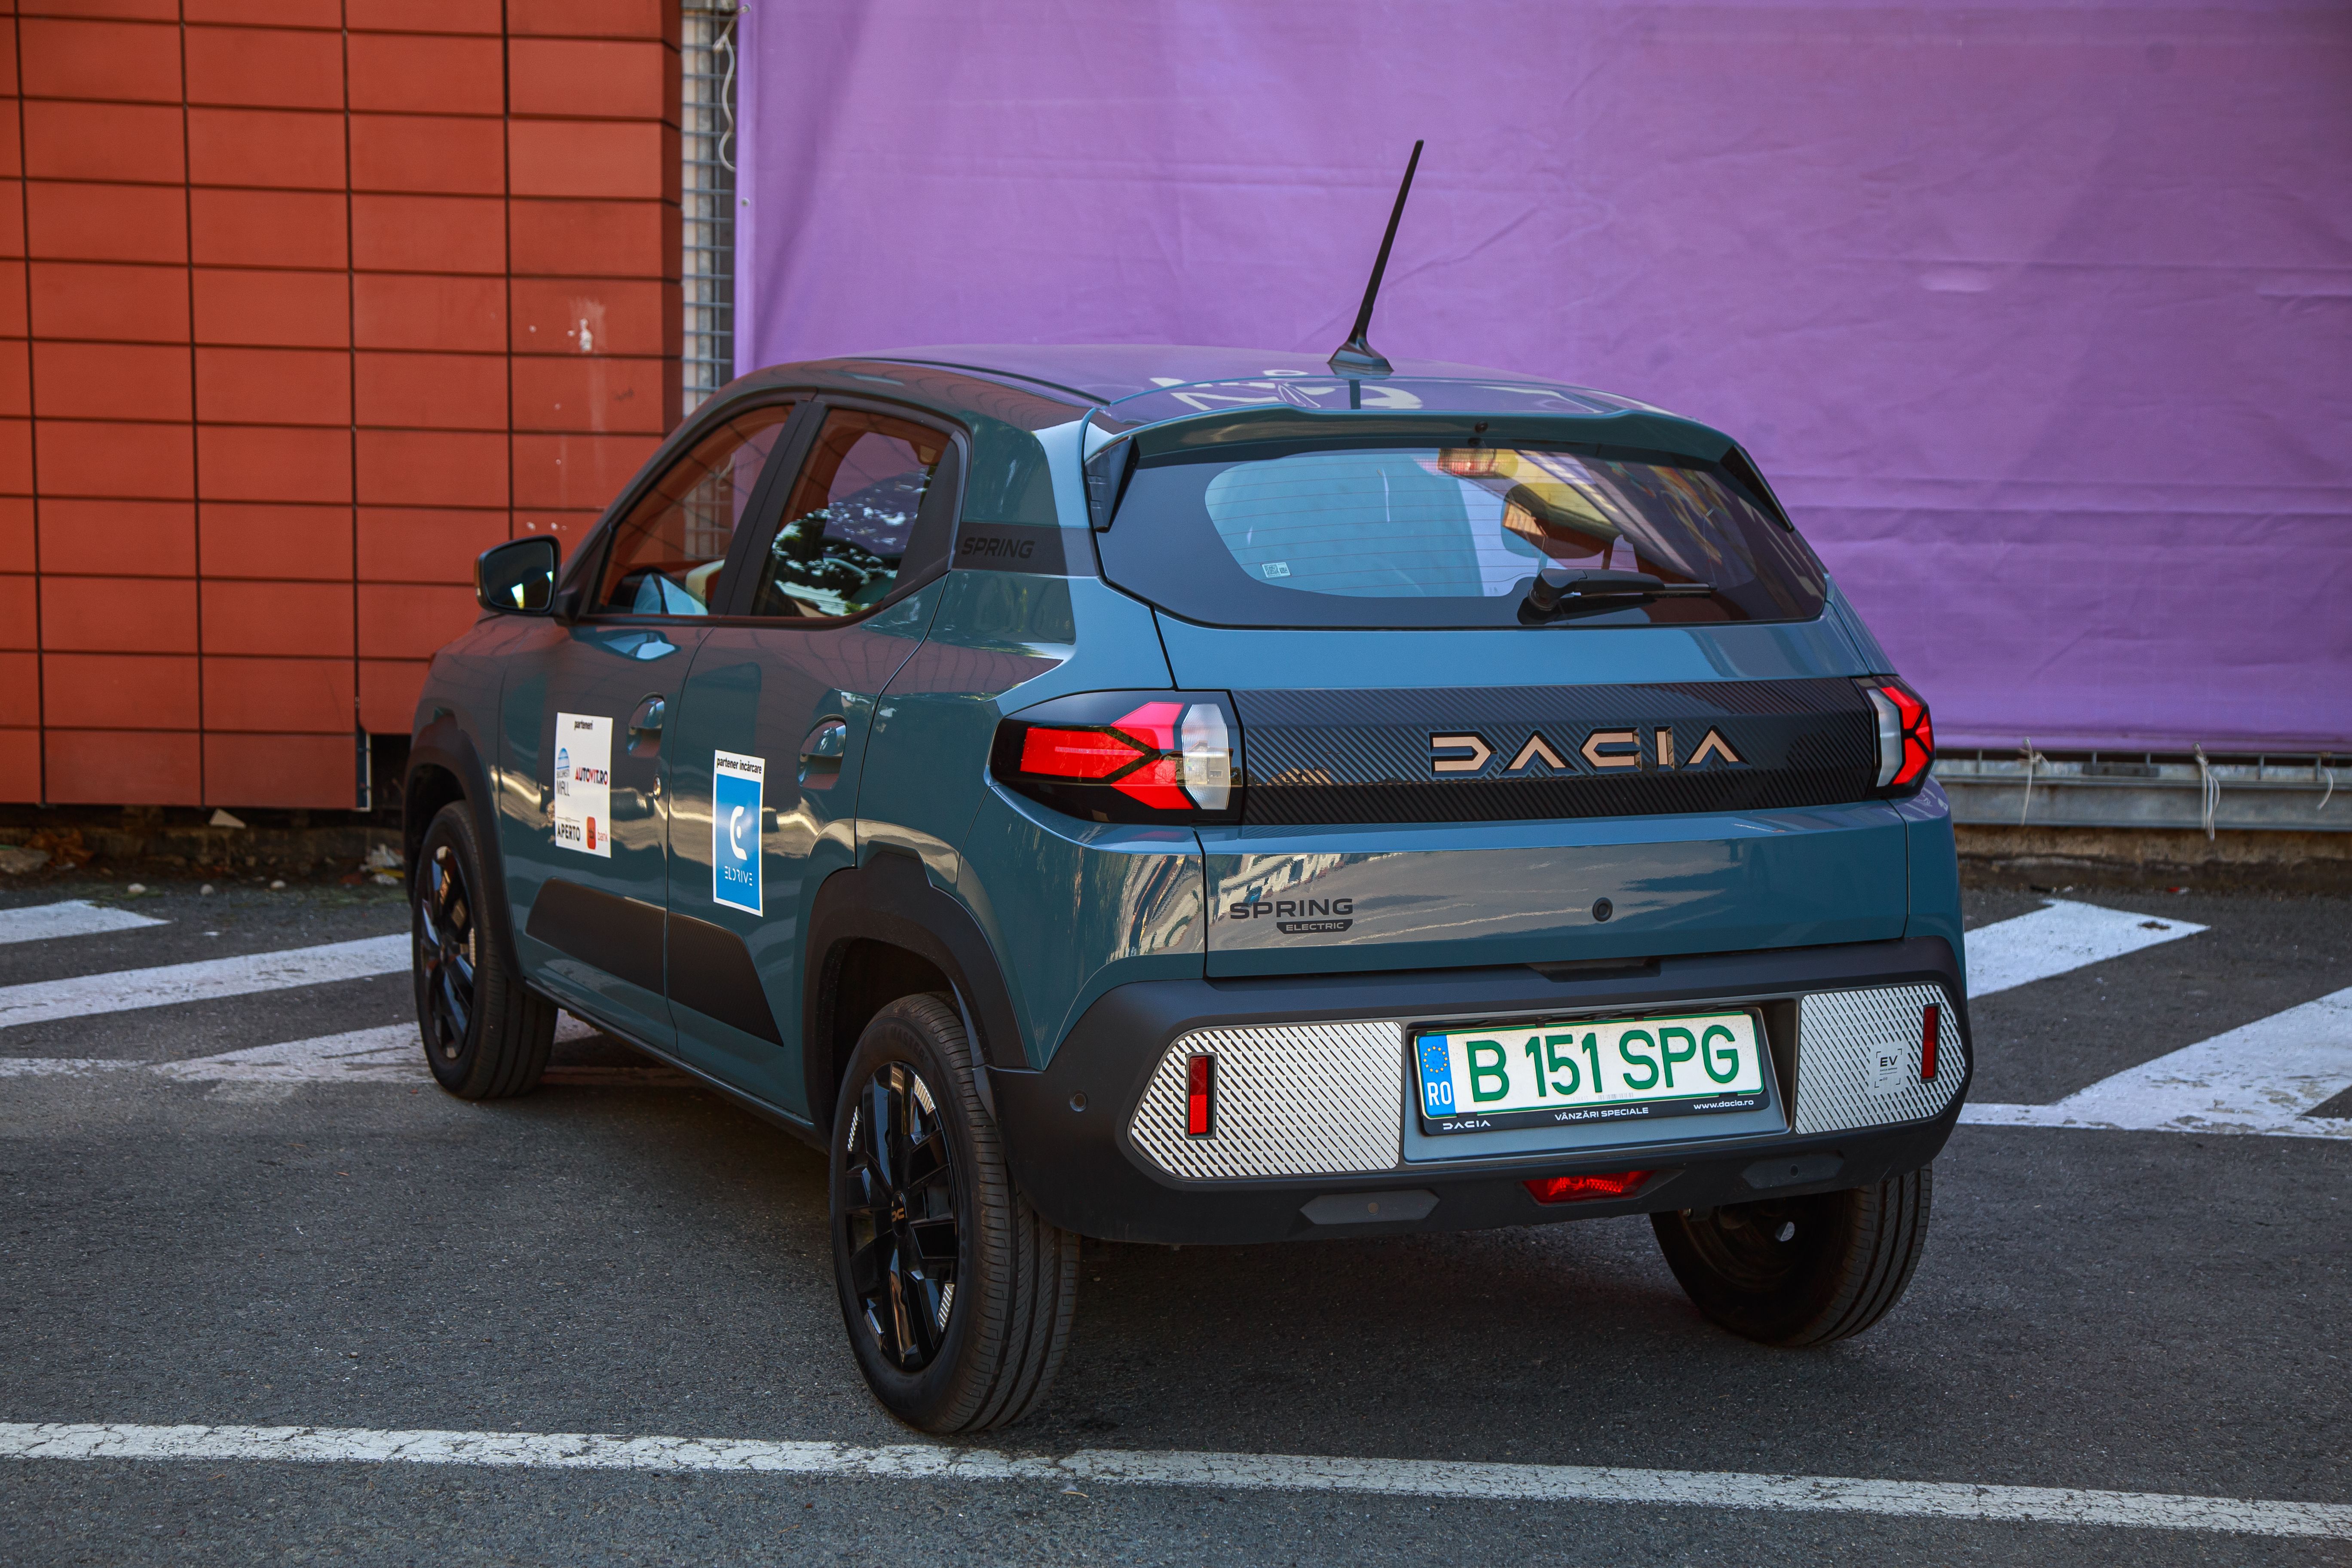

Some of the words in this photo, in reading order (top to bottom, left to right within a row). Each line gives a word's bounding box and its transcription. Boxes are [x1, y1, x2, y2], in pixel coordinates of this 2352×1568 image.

[961, 537, 1035, 558] SPRING
[1429, 726, 1749, 776] DACIA
[717, 757, 738, 769] partener
[557, 823, 580, 842] APERTO
[724, 865, 753, 886] ELDRIVE
[1230, 898, 1353, 919] SPRING
[1286, 922, 1344, 931] ELECTRIC
[1466, 1040, 1510, 1103] B
[1525, 1032, 1603, 1098] 151
[1618, 1024, 1740, 1091] SPG
[1880, 1055, 1898, 1067] EV
[1427, 1081, 1452, 1106] RO
[1554, 1109, 1599, 1121] VÂNZĂRI
[1601, 1107, 1649, 1118] SPECIALE
[1693, 1099, 1754, 1110] www.dacia.ro
[1442, 1120, 1491, 1130] DACIA
